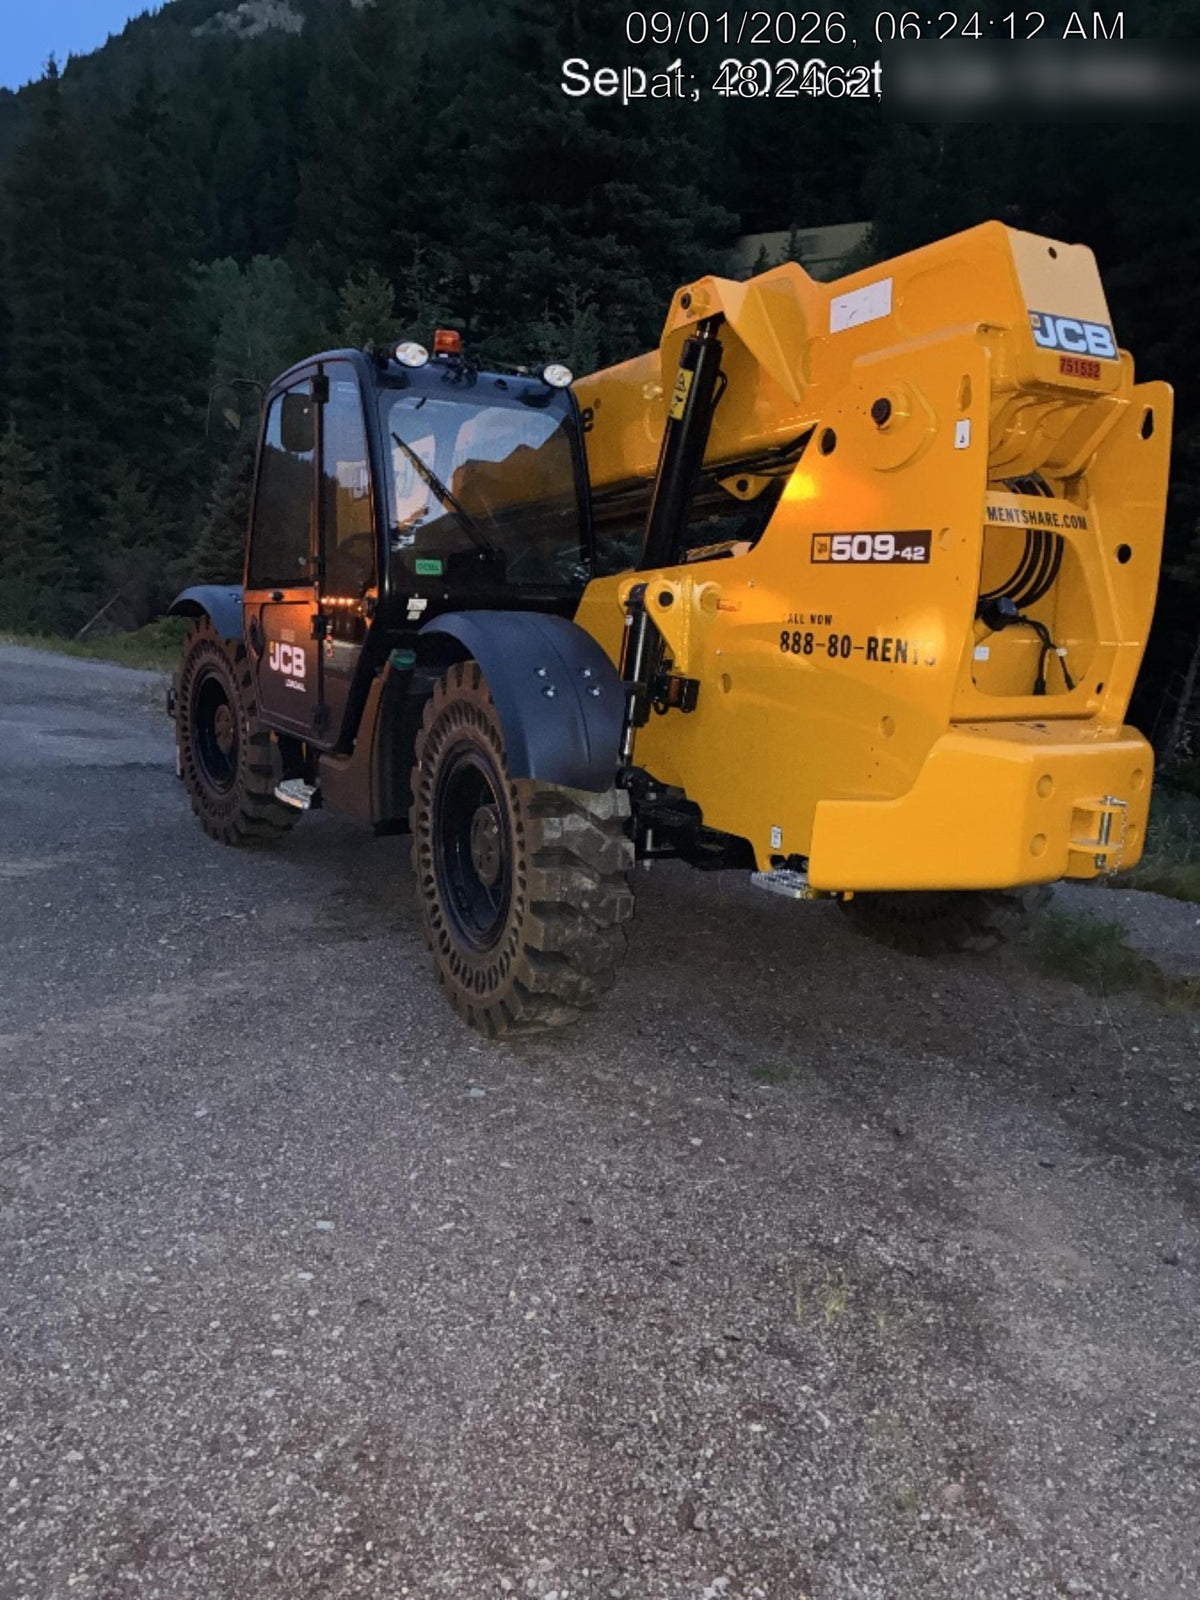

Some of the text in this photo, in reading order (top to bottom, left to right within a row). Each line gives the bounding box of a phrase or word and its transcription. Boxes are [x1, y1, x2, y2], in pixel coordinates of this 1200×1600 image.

[1030, 312, 1117, 358] JCB
[783, 612, 833, 627] ALL NOW
[269, 640, 307, 679] JCB
